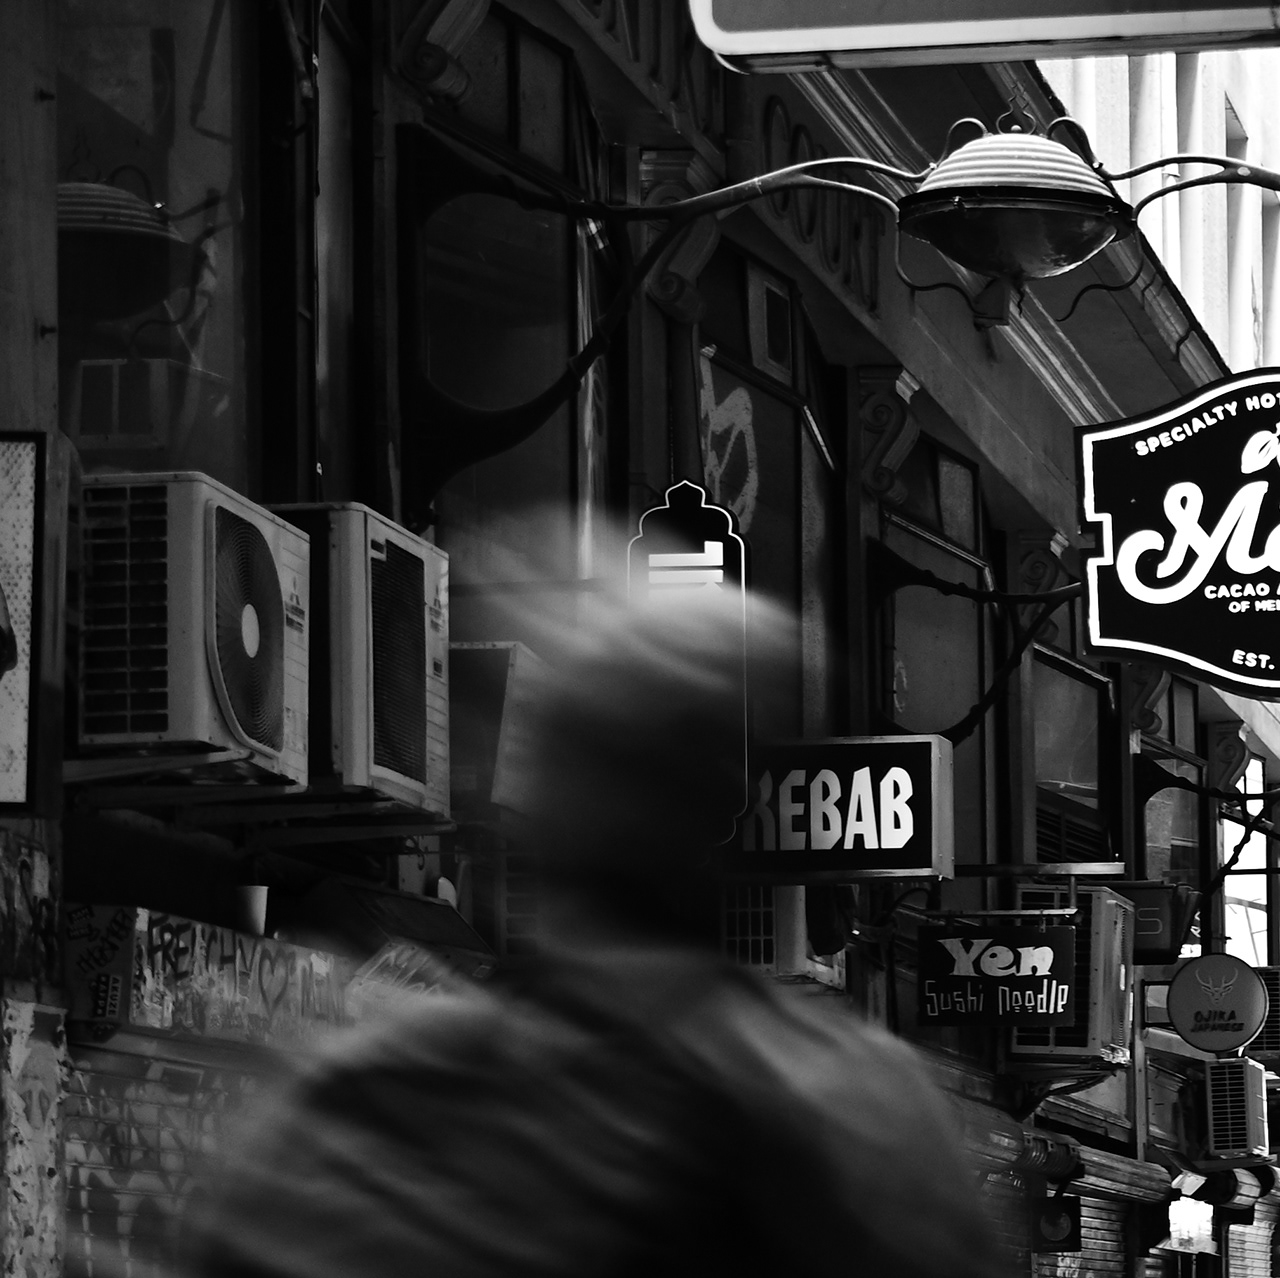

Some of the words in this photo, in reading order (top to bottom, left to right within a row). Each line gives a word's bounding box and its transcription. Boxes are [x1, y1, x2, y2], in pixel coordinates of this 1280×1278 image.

[1135, 400, 1238, 456] SPECIALTY
[1203, 582, 1270, 599] CACAO
[1227, 600, 1250, 613] OF
[1231, 649, 1275, 670] EST.
[937, 938, 1054, 977] Yen
[925, 980, 984, 1016] Sushi
[1193, 1010, 1237, 1023] OJIKA
[1190, 1022, 1245, 1033] JAPANESE
